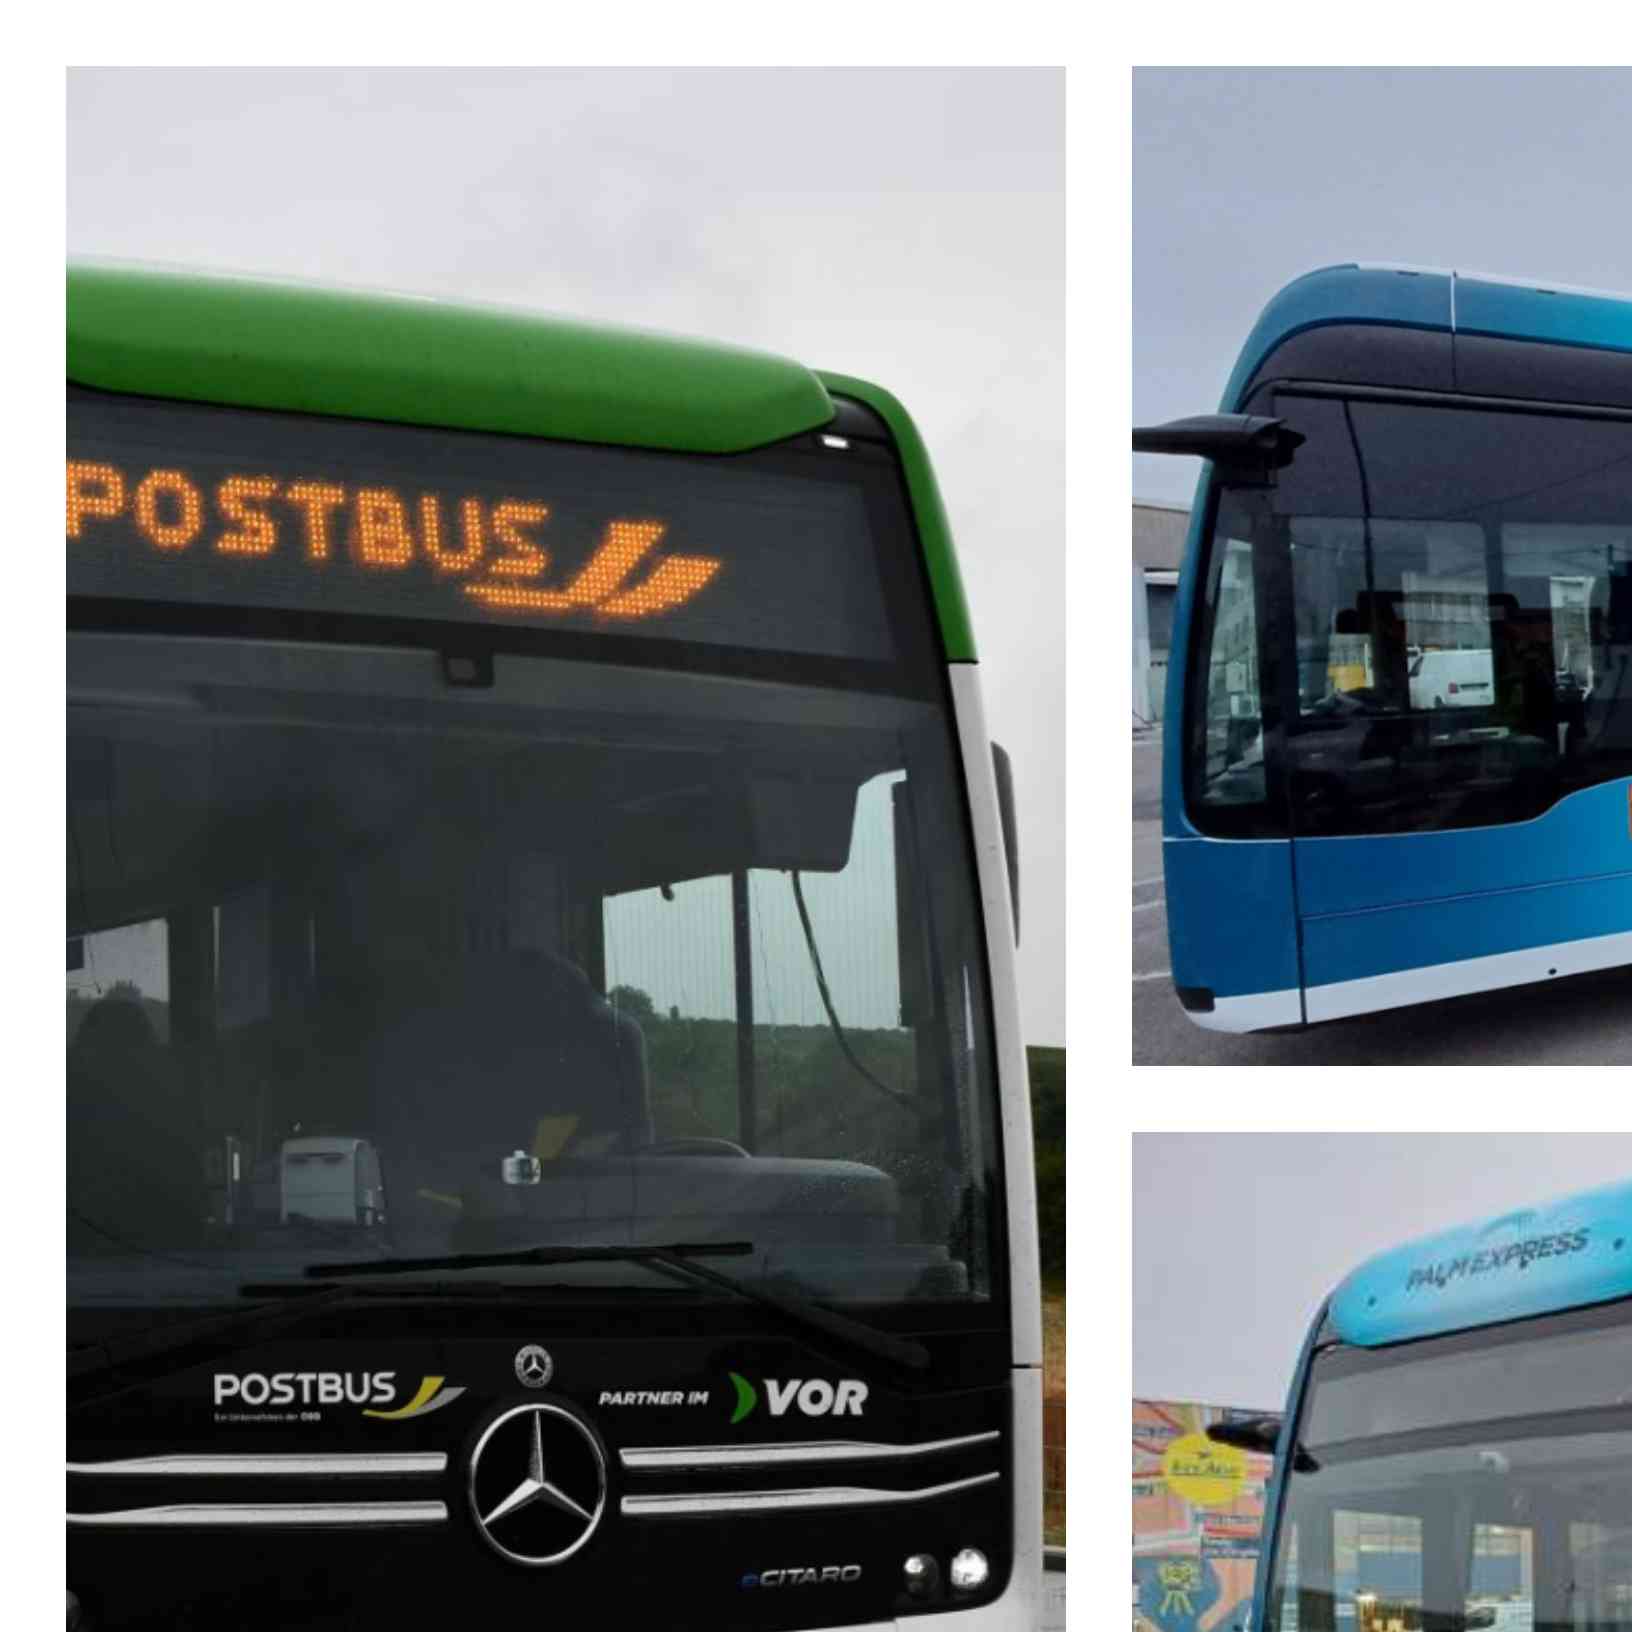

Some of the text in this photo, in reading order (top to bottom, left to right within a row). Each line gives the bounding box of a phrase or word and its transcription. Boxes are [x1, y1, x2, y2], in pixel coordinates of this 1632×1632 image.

[66, 459, 549, 577] POSTBUS
[1470, 1228, 1591, 1275] EXPRESS
[213, 1371, 396, 1406] POSTBUS
[599, 1391, 709, 1406] PARTNER IM
[762, 1378, 869, 1417] VOR
